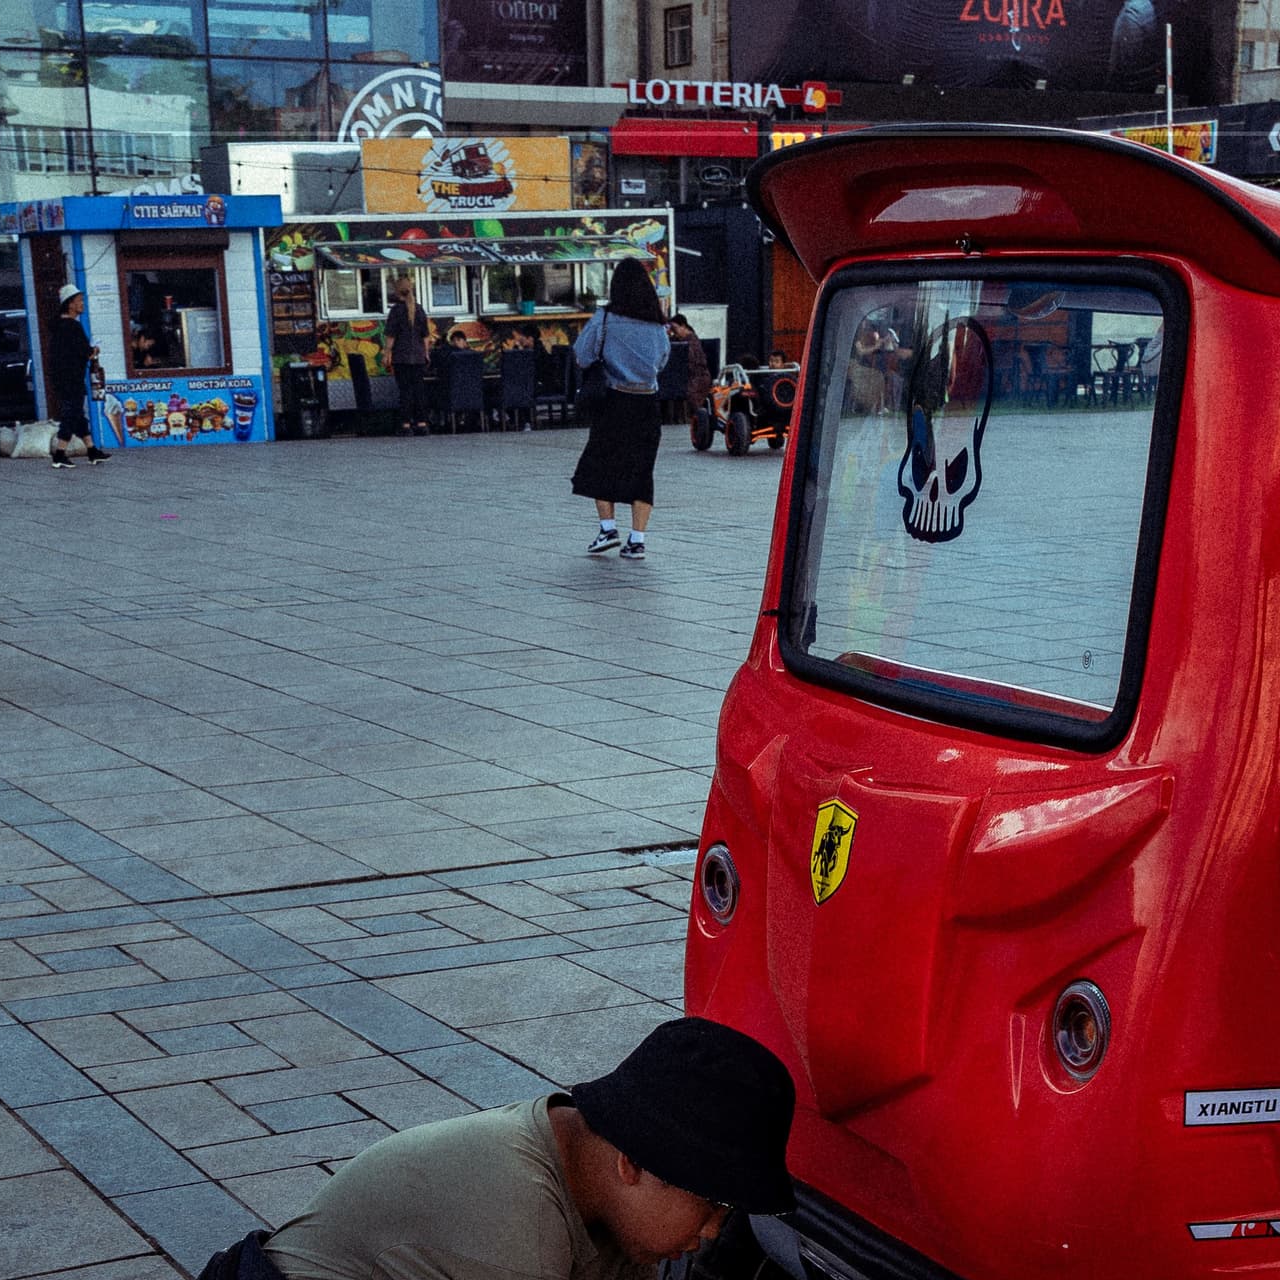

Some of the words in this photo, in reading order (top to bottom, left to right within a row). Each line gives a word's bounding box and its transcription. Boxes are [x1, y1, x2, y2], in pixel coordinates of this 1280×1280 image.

[628, 78, 787, 109] LOTTERIA
[431, 181, 460, 195] THE
[448, 195, 494, 208] TRUCK
[160, 202, 203, 218] ЗАЙРМАГ
[128, 380, 172, 392] ЗАЙРМАГ
[188, 380, 227, 390] МӨСТЭЙ
[228, 379, 252, 388] КОЛА
[1198, 1098, 1278, 1118] XIANGTU
